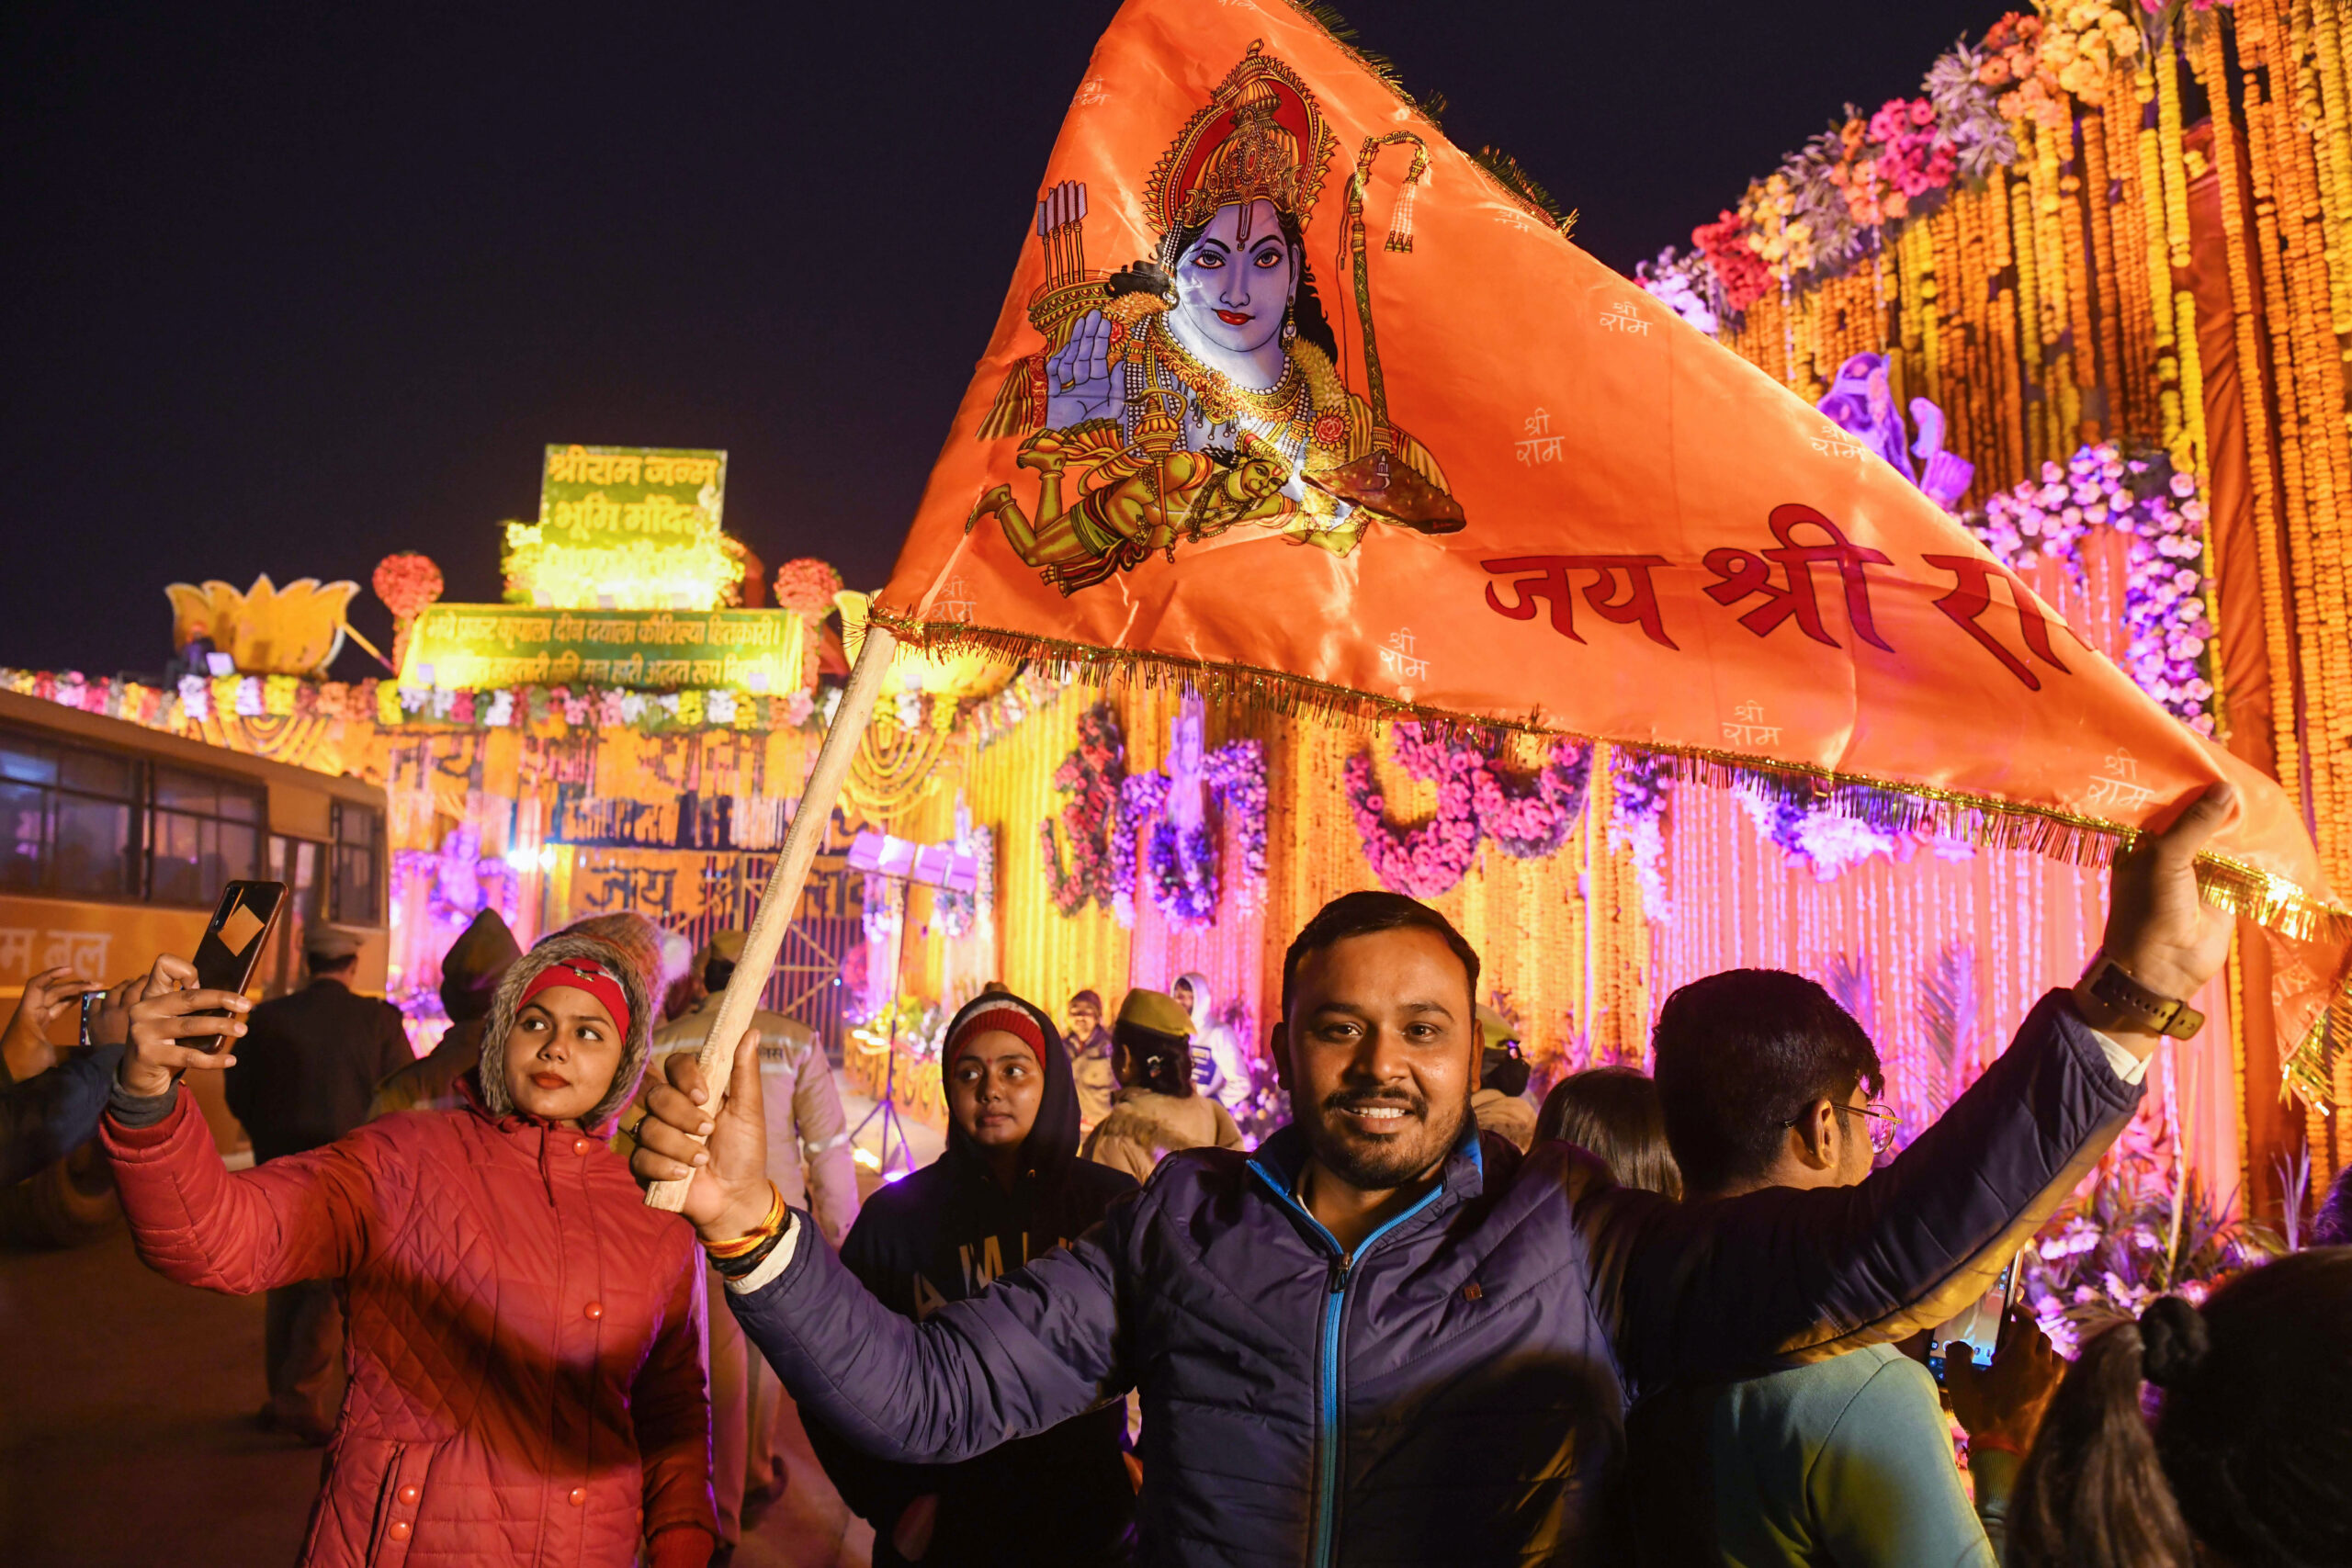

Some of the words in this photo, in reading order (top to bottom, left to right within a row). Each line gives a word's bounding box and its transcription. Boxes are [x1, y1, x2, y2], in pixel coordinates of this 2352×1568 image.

[1612, 300, 1639, 318] श्री
[1599, 311, 1653, 337] राम
[1524, 407, 1551, 436] श्री
[1514, 435, 1566, 468] राम
[1808, 435, 1867, 462] राम
[548, 445, 642, 486] श्रीराम
[644, 457, 718, 488] जन्म
[941, 574, 966, 598] श्री
[1480, 554, 1680, 651] जय
[1702, 502, 1895, 653] श्री
[1920, 553, 2075, 692] रा
[1389, 626, 1417, 655] श्री
[1377, 645, 1430, 682] राम
[1734, 699, 1764, 724] श्री
[1722, 721, 1782, 747] राम
[2103, 746, 2138, 780] श्री
[2087, 774, 2154, 812] राम
[585, 866, 677, 918] जय
